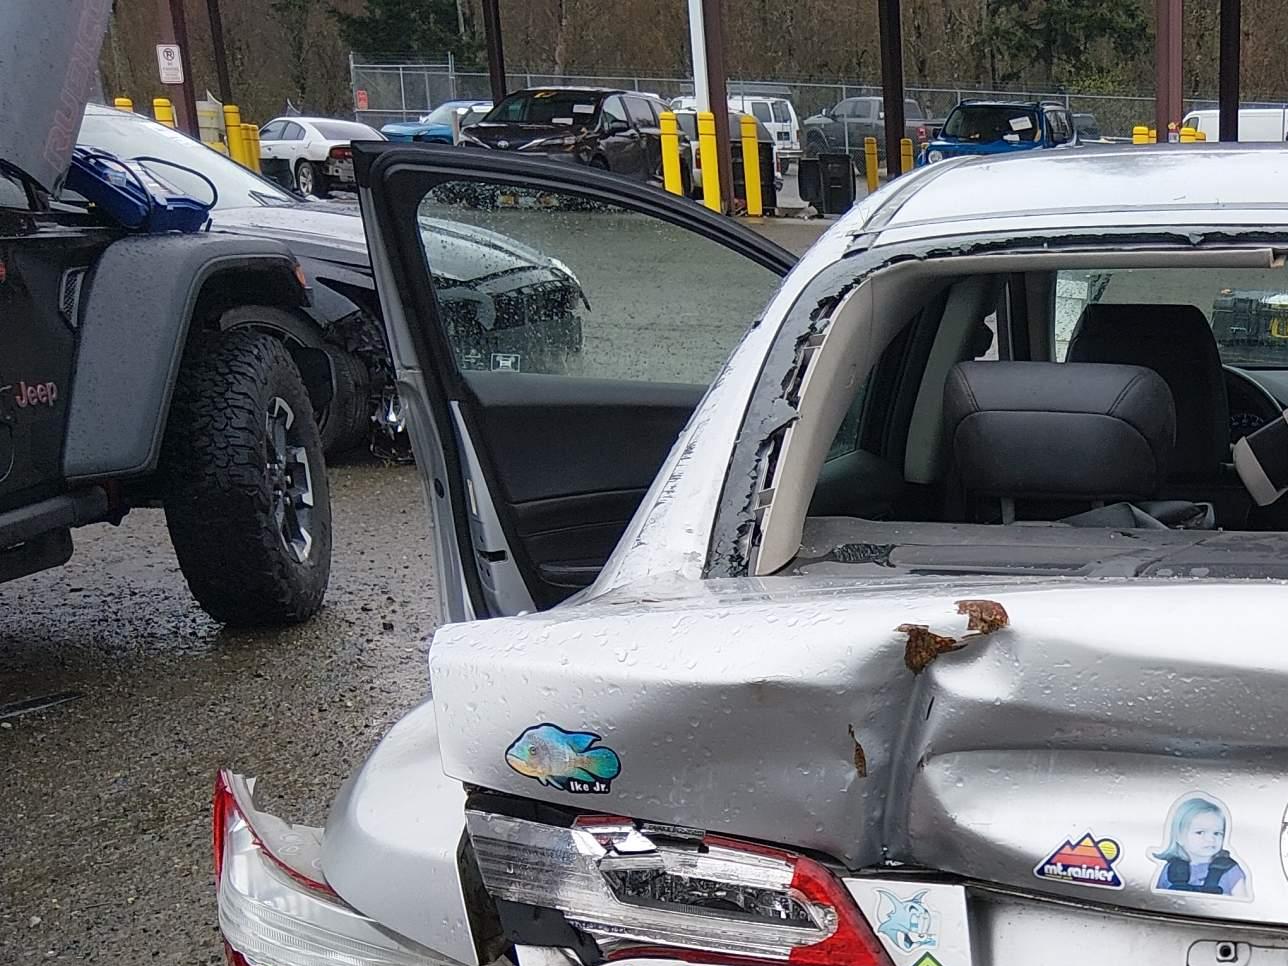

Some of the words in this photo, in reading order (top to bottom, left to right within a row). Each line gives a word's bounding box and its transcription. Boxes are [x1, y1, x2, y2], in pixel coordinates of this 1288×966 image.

[43, 0, 105, 174] RUBIC
[16, 381, 57, 408] Jeep
[569, 781, 590, 792] Ike
[593, 781, 609, 792] Jr.
